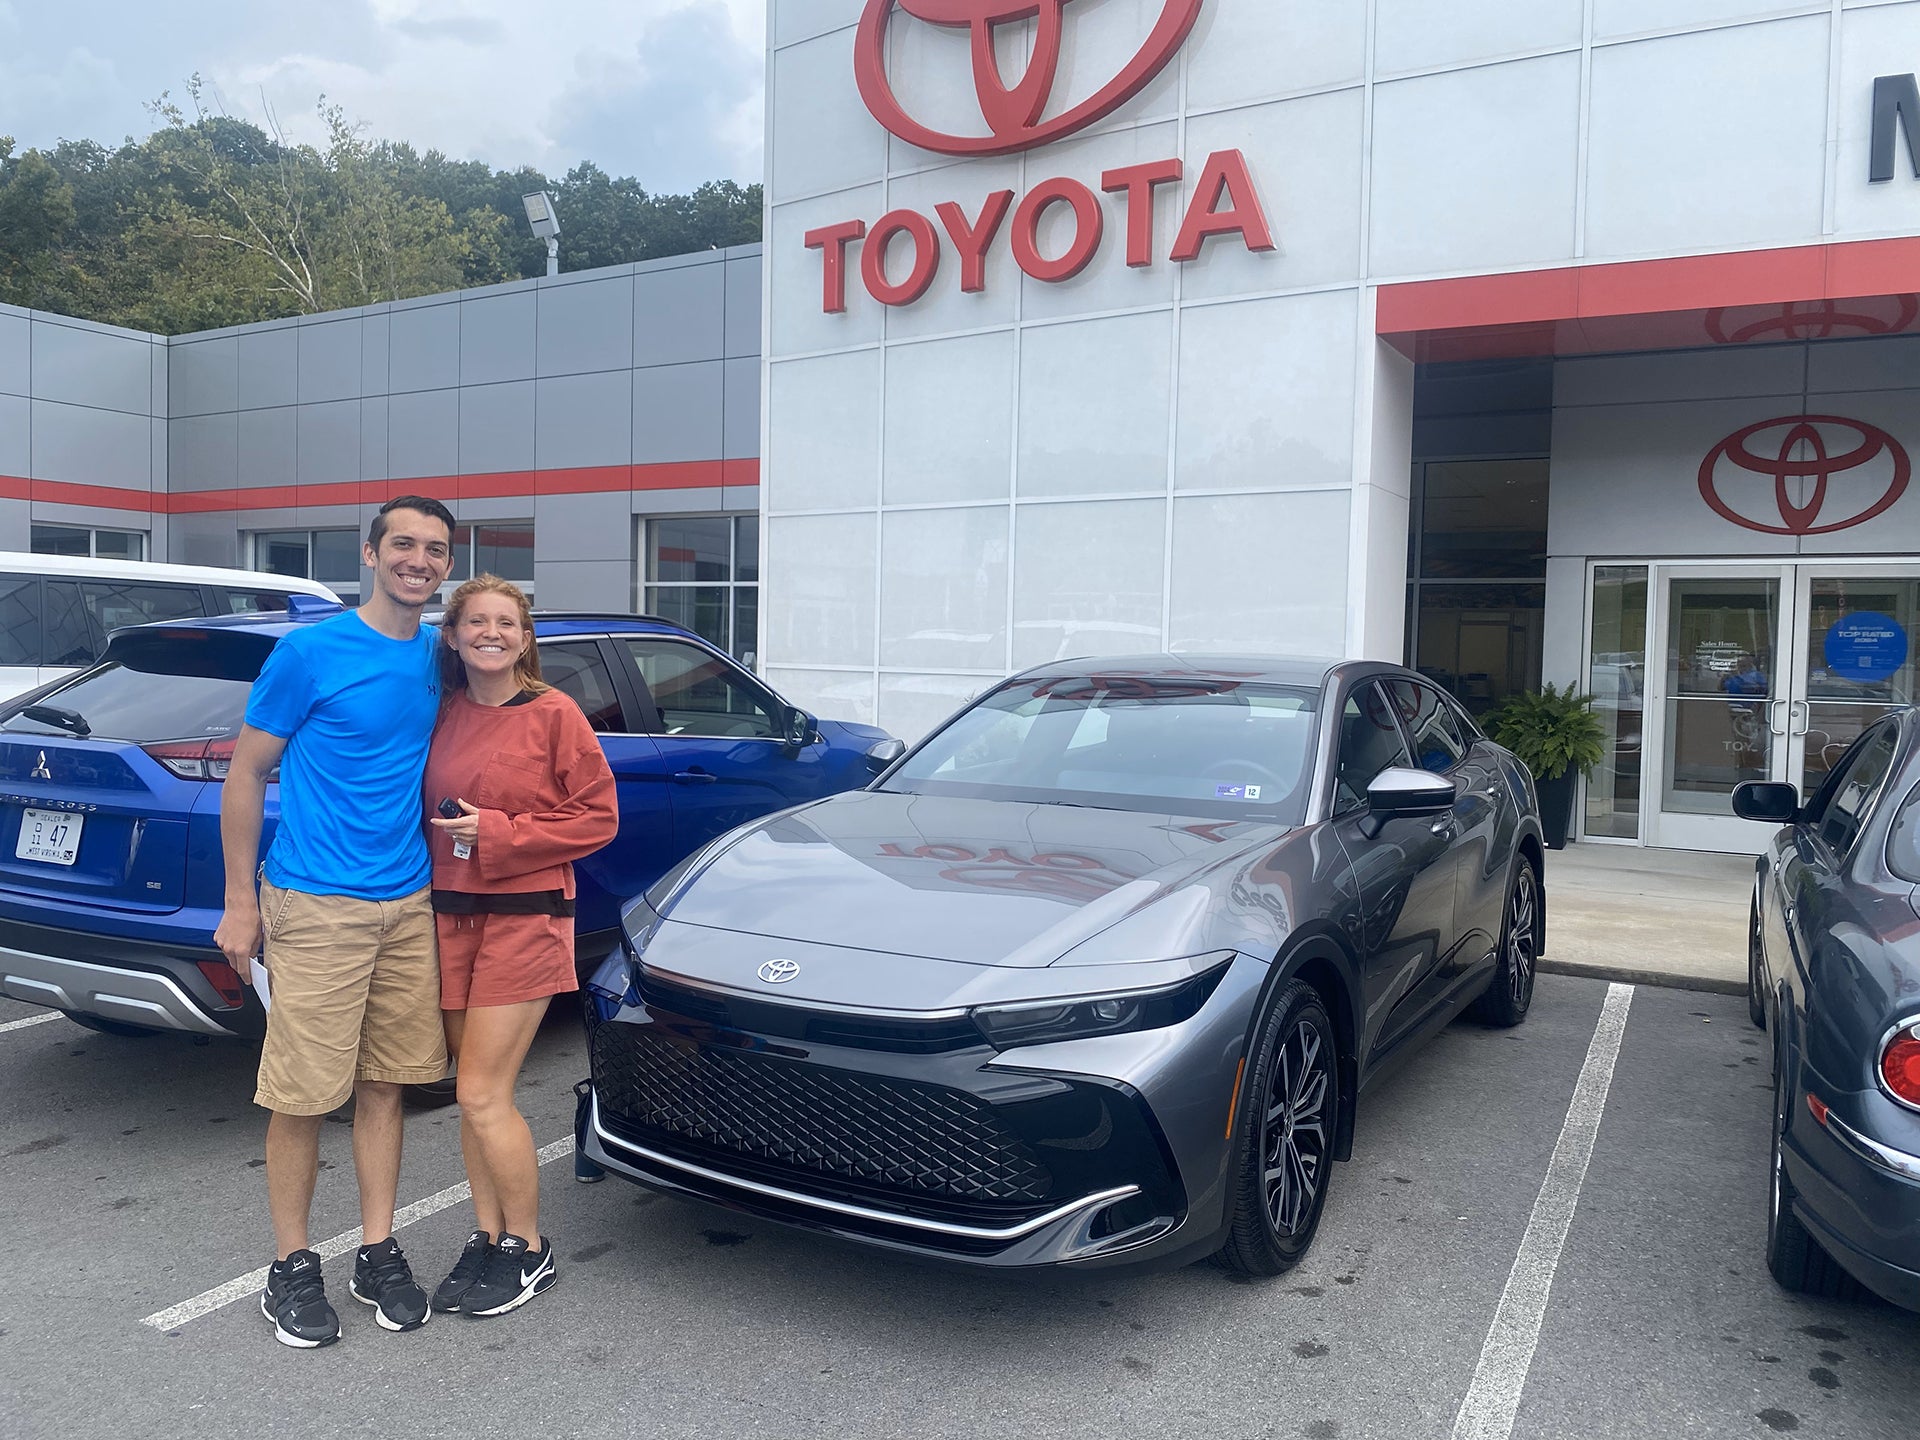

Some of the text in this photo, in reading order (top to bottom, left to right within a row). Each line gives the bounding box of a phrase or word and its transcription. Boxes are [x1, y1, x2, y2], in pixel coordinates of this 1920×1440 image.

[804, 148, 1277, 313] TOYOTA
[1248, 788, 1257, 796] 12
[46, 799, 97, 812] CROSS
[31, 834, 41, 846] 11
[49, 824, 69, 848] 47
[146, 881, 162, 890] SE
